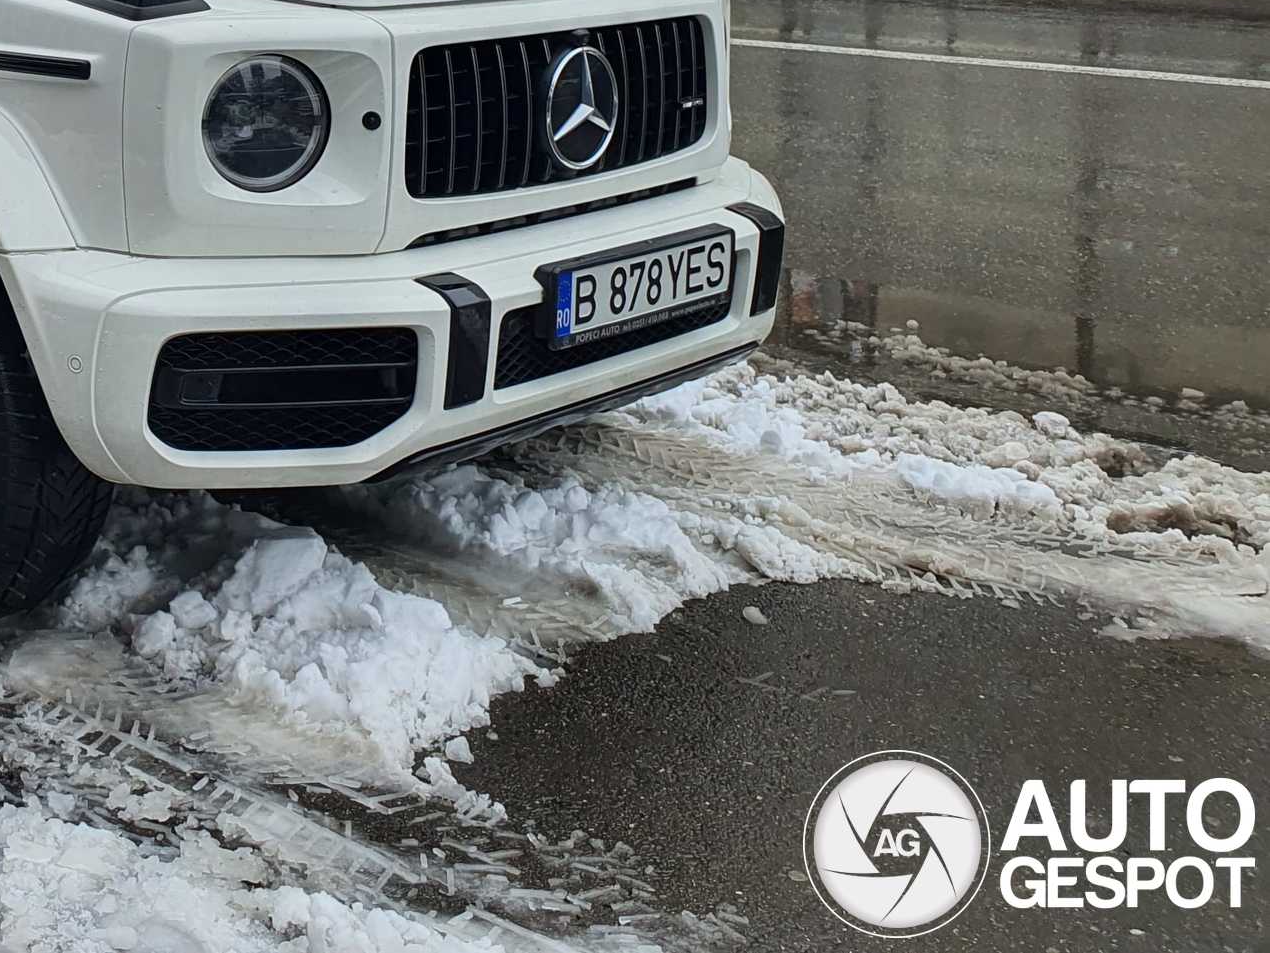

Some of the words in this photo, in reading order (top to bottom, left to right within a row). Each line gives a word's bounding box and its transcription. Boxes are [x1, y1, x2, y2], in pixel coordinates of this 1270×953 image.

[574, 274, 597, 326] B
[556, 308, 570, 329] RO
[575, 328, 600, 344] POPECI
[600, 324, 620, 338] AUTO
